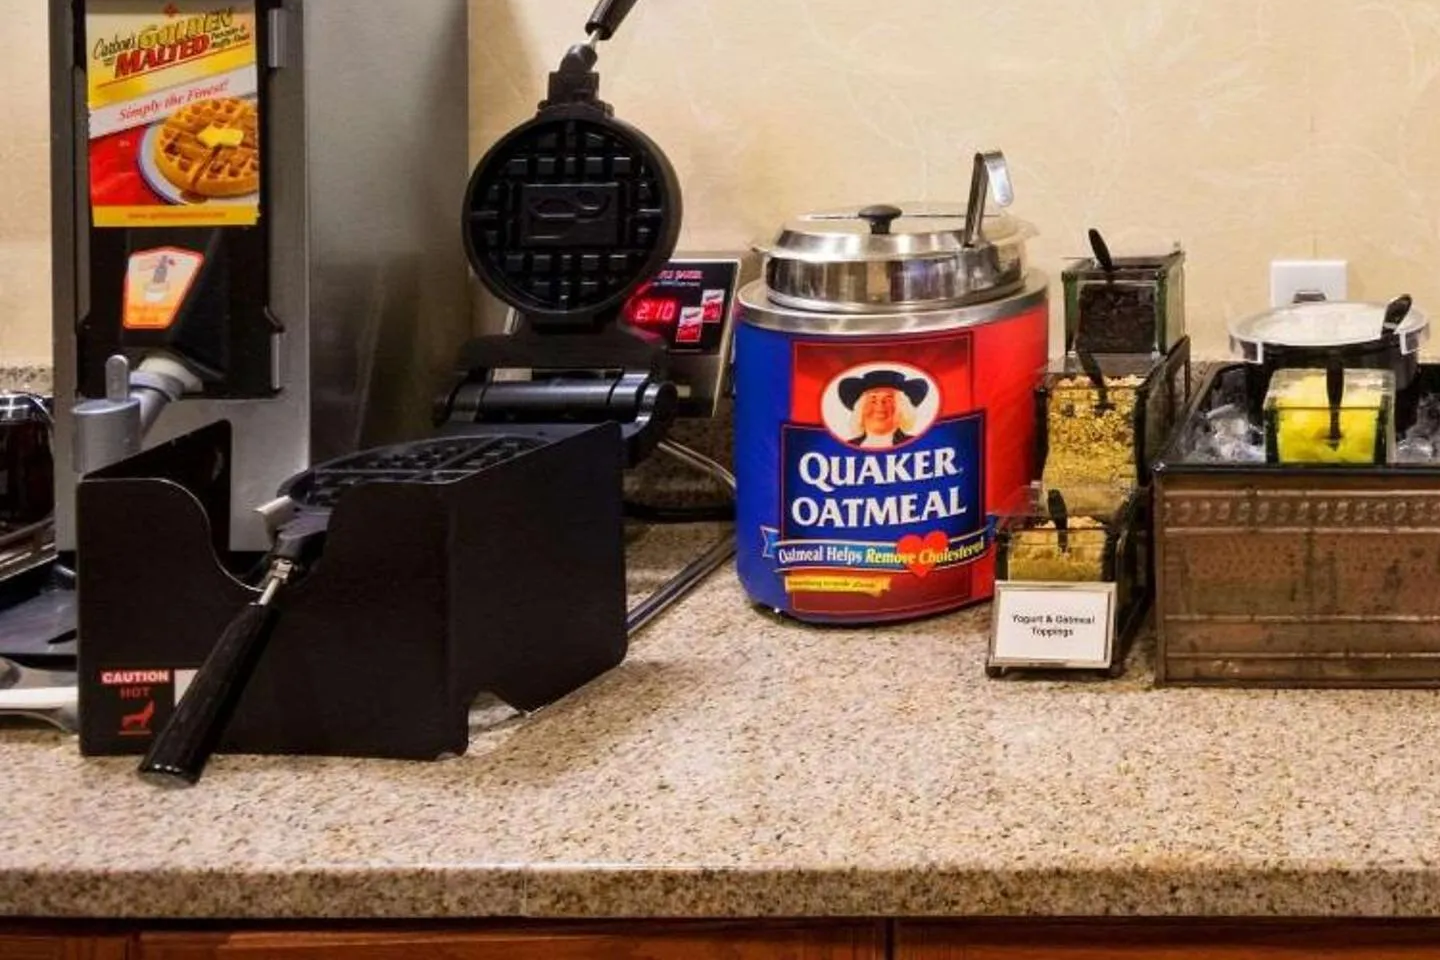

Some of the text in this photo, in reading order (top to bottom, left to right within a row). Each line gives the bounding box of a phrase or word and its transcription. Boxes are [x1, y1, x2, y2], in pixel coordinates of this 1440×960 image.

[114, 33, 212, 78] MALTED
[119, 98, 159, 121] Simply
[164, 94, 184, 109] the
[798, 446, 962, 493] QUAKER
[791, 486, 968, 529] OATMEAL
[778, 536, 986, 566] Oatmeal Helps Remove Cholesterol
[1012, 614, 1096, 625] Yogurt & Oatmeal
[1031, 627, 1074, 639] Toppings
[101, 670, 170, 685] CAUTION
[120, 686, 151, 699] HOT
